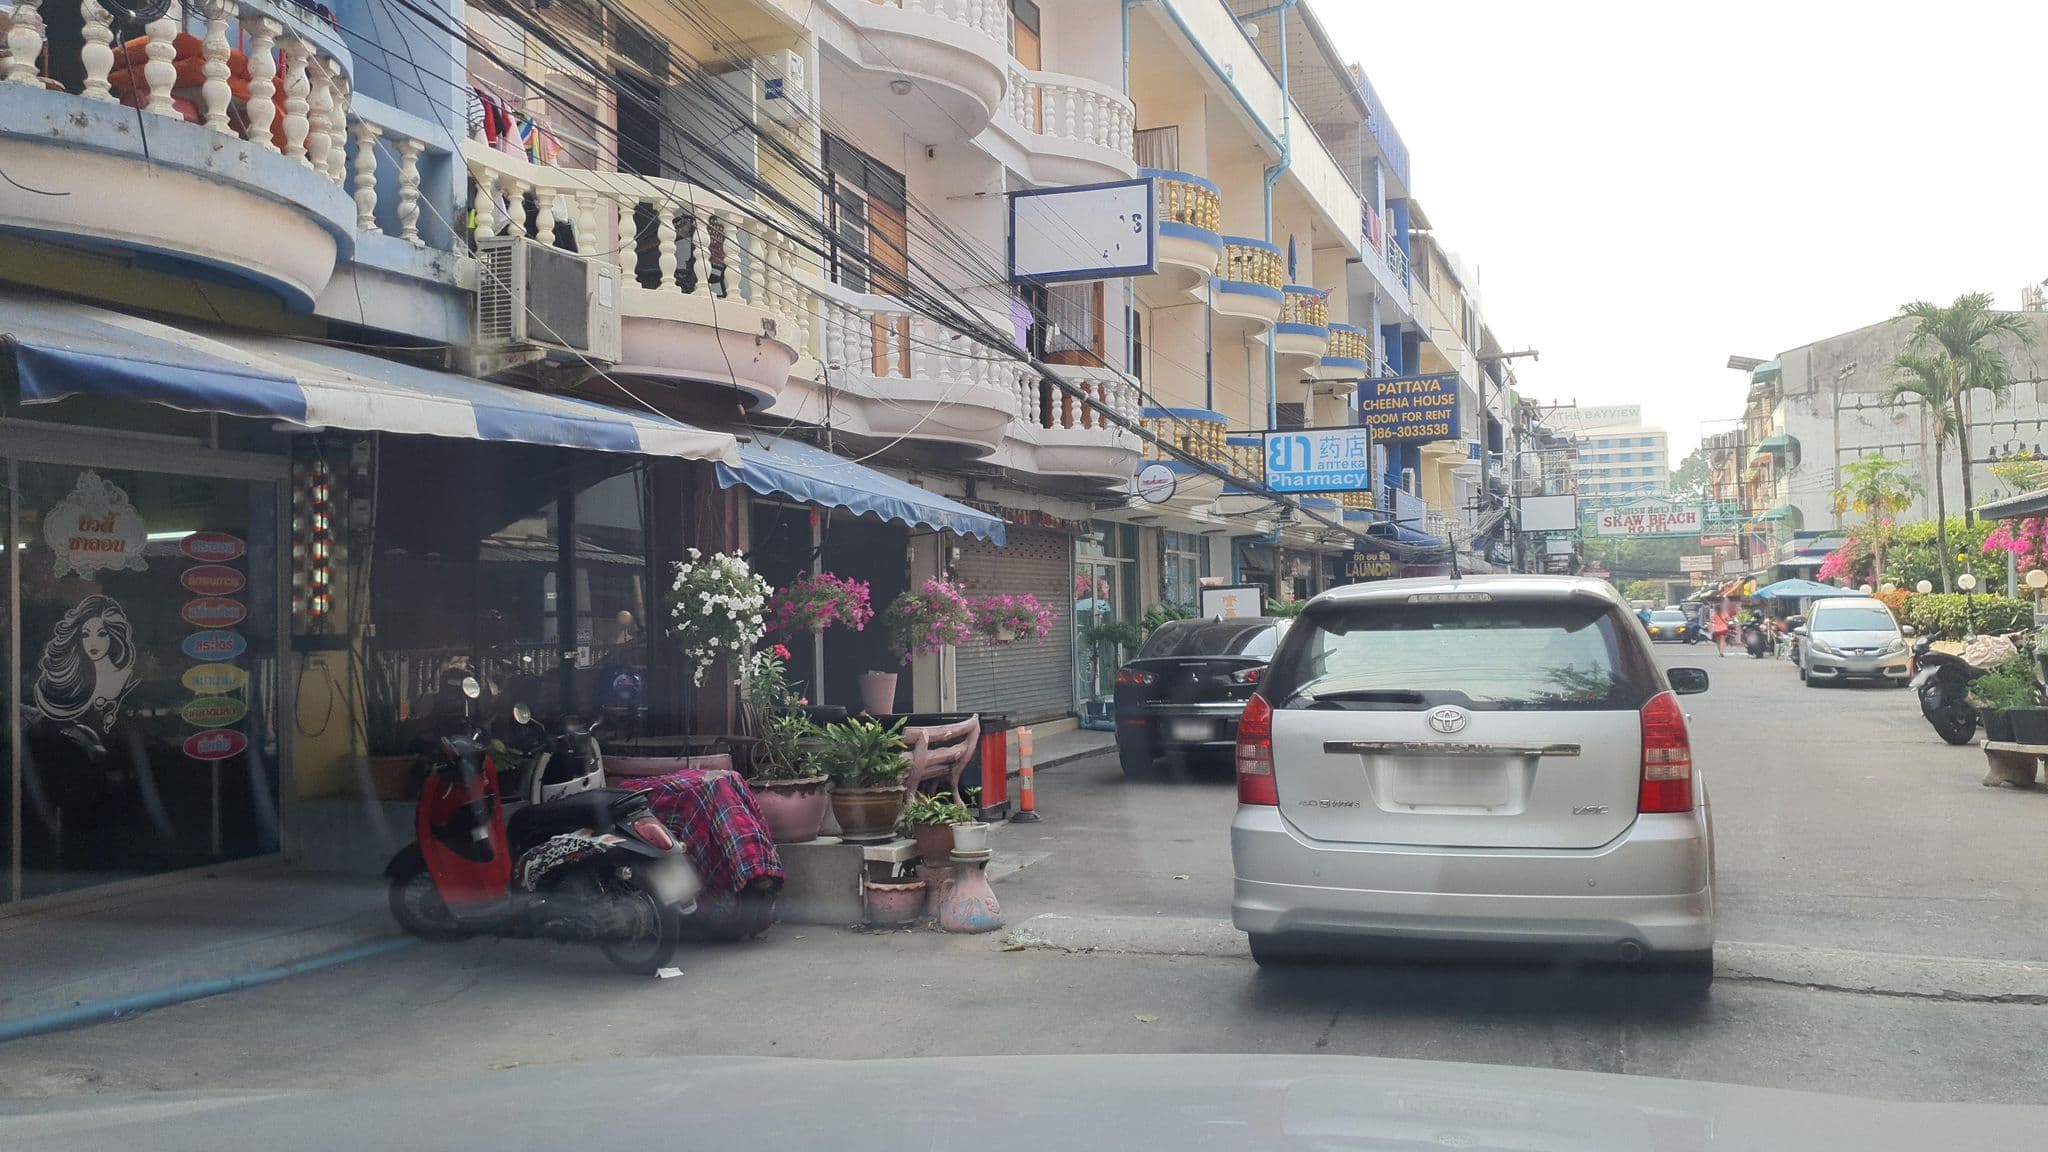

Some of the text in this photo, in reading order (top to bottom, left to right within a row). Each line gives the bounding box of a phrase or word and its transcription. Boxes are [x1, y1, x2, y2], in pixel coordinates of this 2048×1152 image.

[1376, 379, 1441, 396] PATTAYA
[1363, 393, 1455, 411] CHEENA HOUSE
[1366, 409, 1452, 425] ROOM FOR RENT
[1584, 408, 1640, 419] BAYVIEW
[1371, 423, 1449, 440] 086-3033538
[1269, 435, 1311, 471] ยา
[1319, 434, 1365, 458] 药店
[1317, 460, 1365, 471] аптека
[1268, 472, 1366, 488] Pharmacy
[1603, 512, 1697, 528] SKAW BEACH
[1628, 524, 1671, 534] HOTEL
[1345, 562, 1393, 577] LAUNDR
